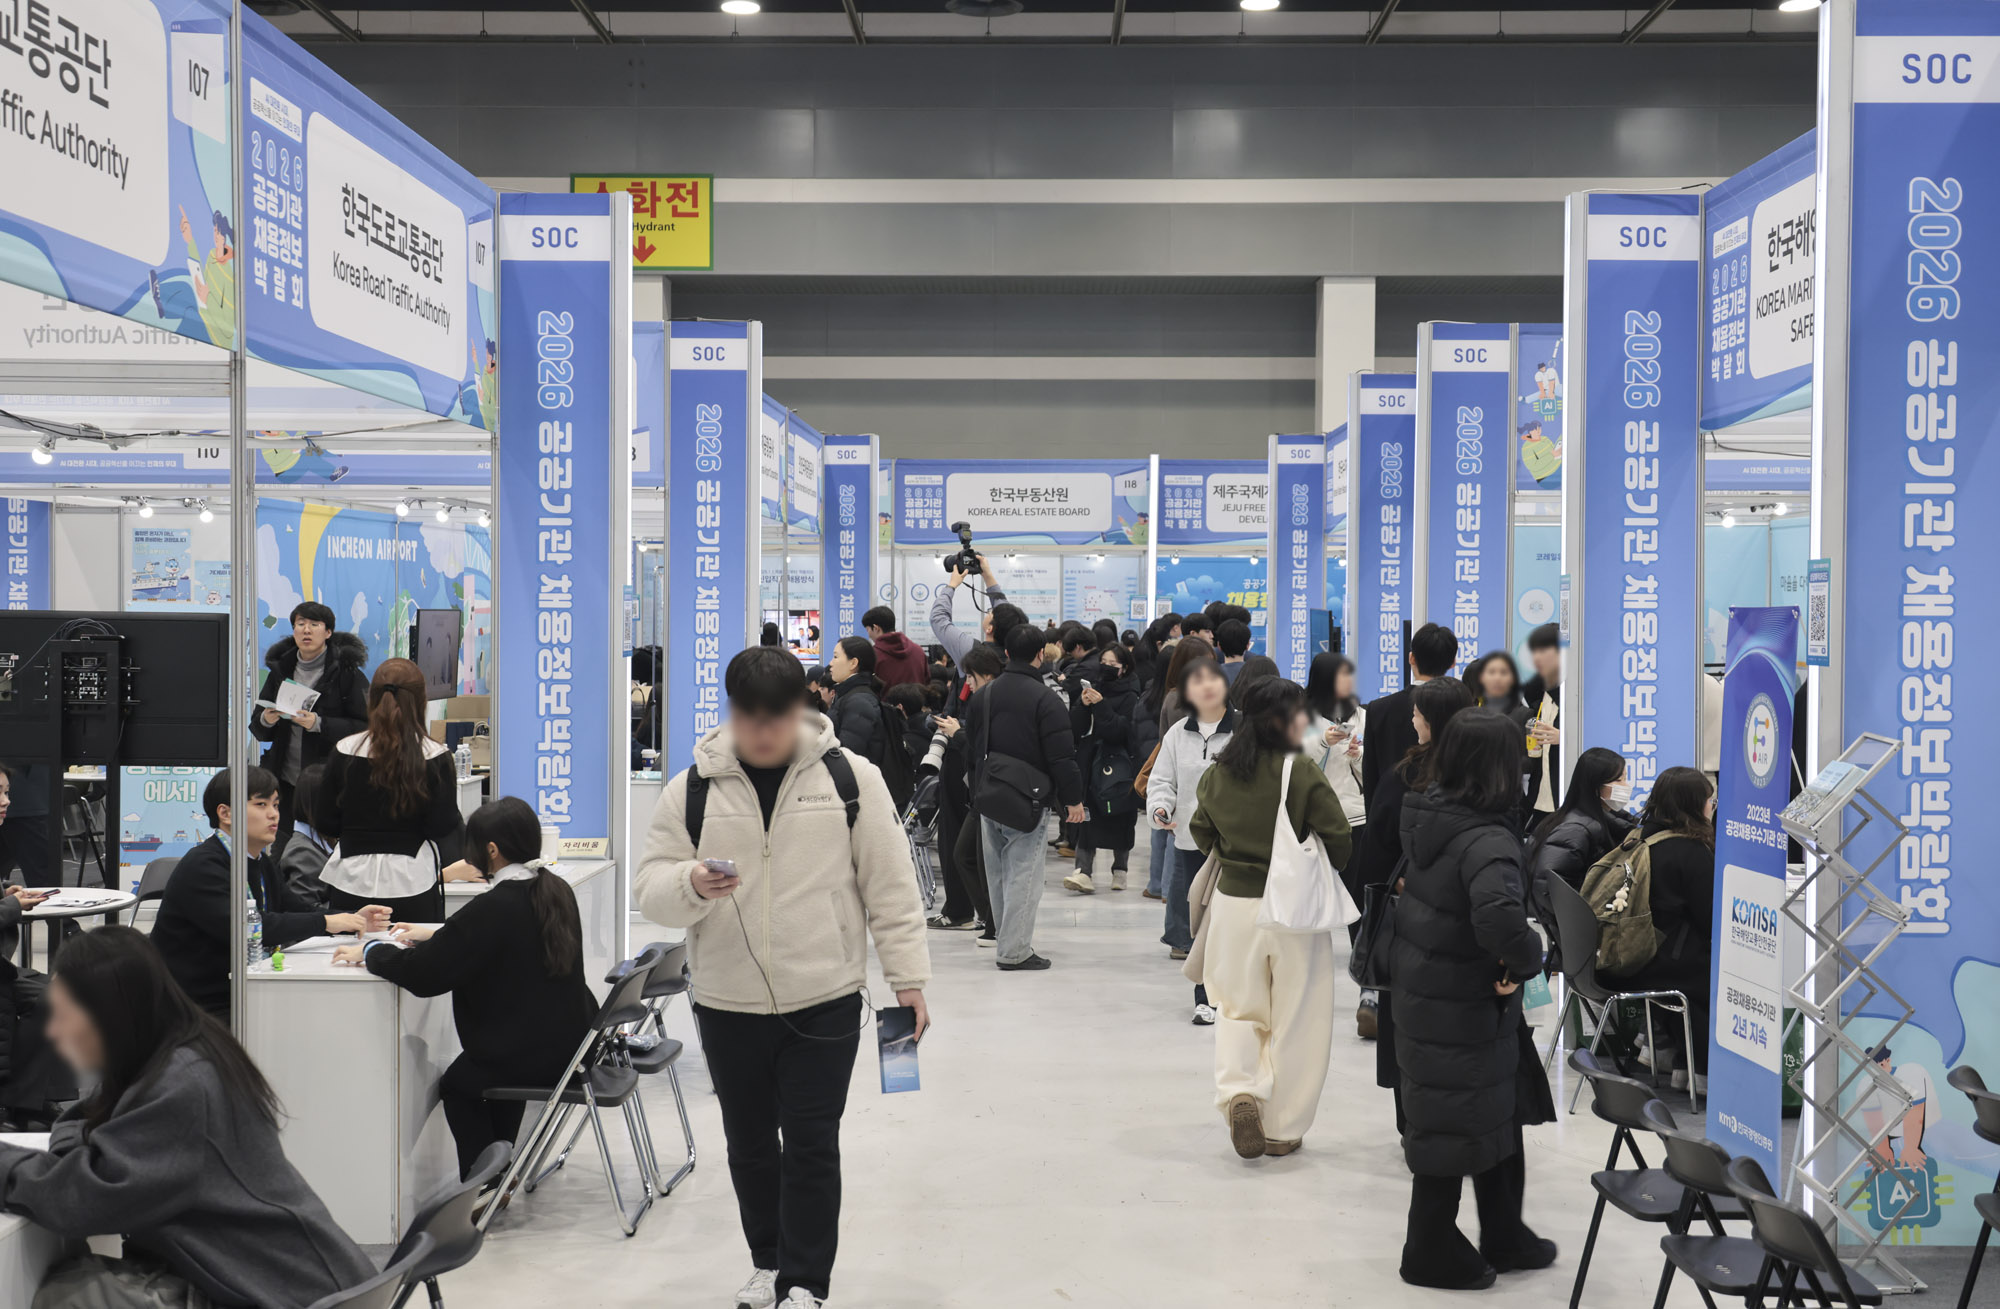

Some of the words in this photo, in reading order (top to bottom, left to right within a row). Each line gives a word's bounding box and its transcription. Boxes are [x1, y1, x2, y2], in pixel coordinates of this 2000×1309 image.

[1902, 53, 1972, 84] SOC
[40, 110, 129, 190] Authority
[252, 131, 303, 192] 2026
[253, 173, 302, 230] 공공기관
[596, 181, 699, 218] 화전
[253, 215, 303, 270] 채용정보
[341, 183, 444, 284] 한국도로교통공단
[532, 227, 579, 248] SOC
[632, 222, 675, 233] Hydrant
[1620, 226, 1667, 248] SOC
[1906, 177, 1963, 322] 2026
[333, 250, 361, 288] Korea
[363, 266, 386, 300] Road
[387, 277, 414, 313] Traffic
[414, 292, 451, 335] Authority
[1712, 254, 1748, 295] 2026
[1712, 286, 1747, 324] 공공기관
[1756, 287, 1787, 320] KOREA
[1711, 317, 1746, 353] 채용정보
[537, 311, 574, 409] 2026
[692, 346, 726, 362] SOC
[1454, 348, 1487, 363] SOC
[1624, 310, 1661, 409] 2026
[1378, 395, 1406, 408] SOC
[696, 403, 722, 472] 2026
[837, 450, 857, 460] SOC
[1291, 449, 1311, 459] SOC
[1456, 406, 1483, 475] 2026
[1904, 339, 1958, 552] 공공기관
[1380, 442, 1403, 499] 2026
[538, 420, 573, 565] 공공기관
[839, 484, 855, 526] 2026
[905, 487, 943, 498] 2026
[905, 498, 943, 508] 공공기관
[989, 487, 1069, 502] 한국부동산원
[1165, 498, 1202, 508] 공공기관
[1222, 503, 1243, 512] JEJU
[1244, 503, 1266, 512] FREE
[1292, 483, 1309, 526] 2026
[1623, 420, 1659, 566] 공공기관
[905, 508, 943, 518] 채용정보
[967, 507, 998, 516] KOREA
[1000, 507, 1023, 516] REAL
[1024, 507, 1057, 516] ESTATE
[1058, 507, 1091, 516] BOARD
[1165, 508, 1202, 519] 채용정보
[1239, 515, 1268, 524] DEVEL
[696, 480, 721, 580] 공공기관
[1380, 504, 1401, 587] 공공기관
[1455, 482, 1481, 584] 공공기관
[327, 535, 373, 559] INCHEON
[376, 538, 418, 562] AIRPORT
[839, 530, 855, 590] 공공기관
[1292, 530, 1308, 590] 공공기관
[537, 574, 573, 824] 채용정보박람회
[1757, 752, 1768, 765] AIR
[1900, 566, 1955, 935] 채용정보박람회
[143, 779, 198, 803] 에서!
[1746, 804, 1771, 825] 2023년
[1725, 818, 1776, 848] 공정채용우수기관
[1776, 830, 1788, 851] 인증
[1731, 896, 1778, 937] KOMSA
[1731, 925, 1777, 954] 한국해양교통안전공단
[1726, 986, 1777, 1022] 공정채용우수기관
[1732, 1014, 1748, 1040] 2년
[1749, 1021, 1768, 1050] 지속
